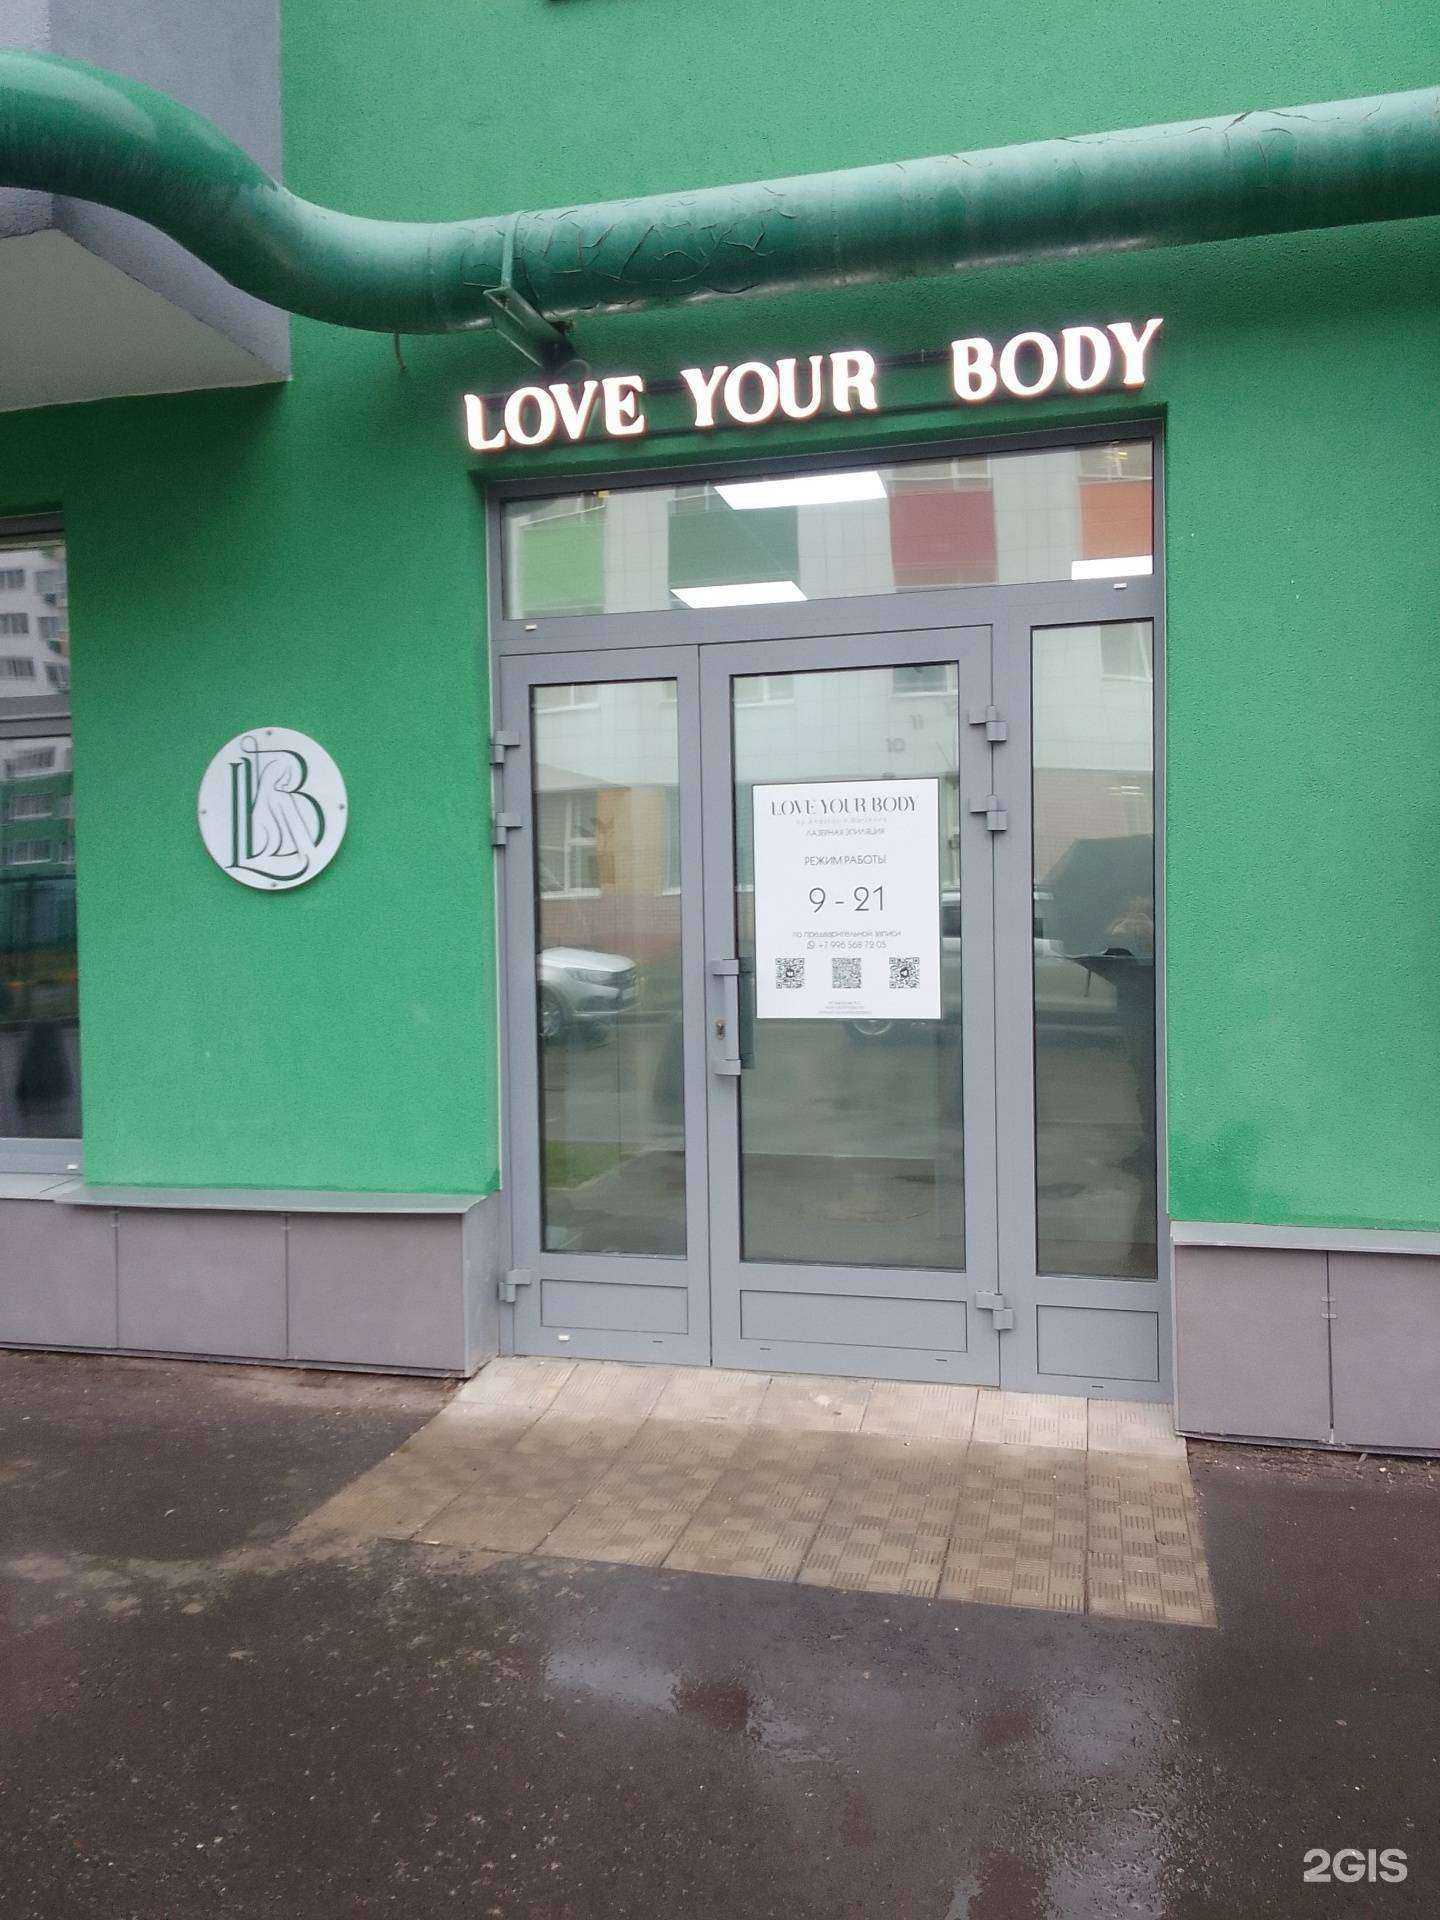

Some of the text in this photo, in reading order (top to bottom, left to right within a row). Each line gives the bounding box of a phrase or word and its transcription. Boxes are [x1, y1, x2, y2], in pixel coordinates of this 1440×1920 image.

[464, 318, 1163, 451] LOVE YOUR BODY
[771, 796, 919, 816] LOVE YOUR BODY
[804, 854, 886, 866] РЕЖИМ РАБОТЫ
[809, 887, 826, 913] 9
[853, 885, 884, 912] 21
